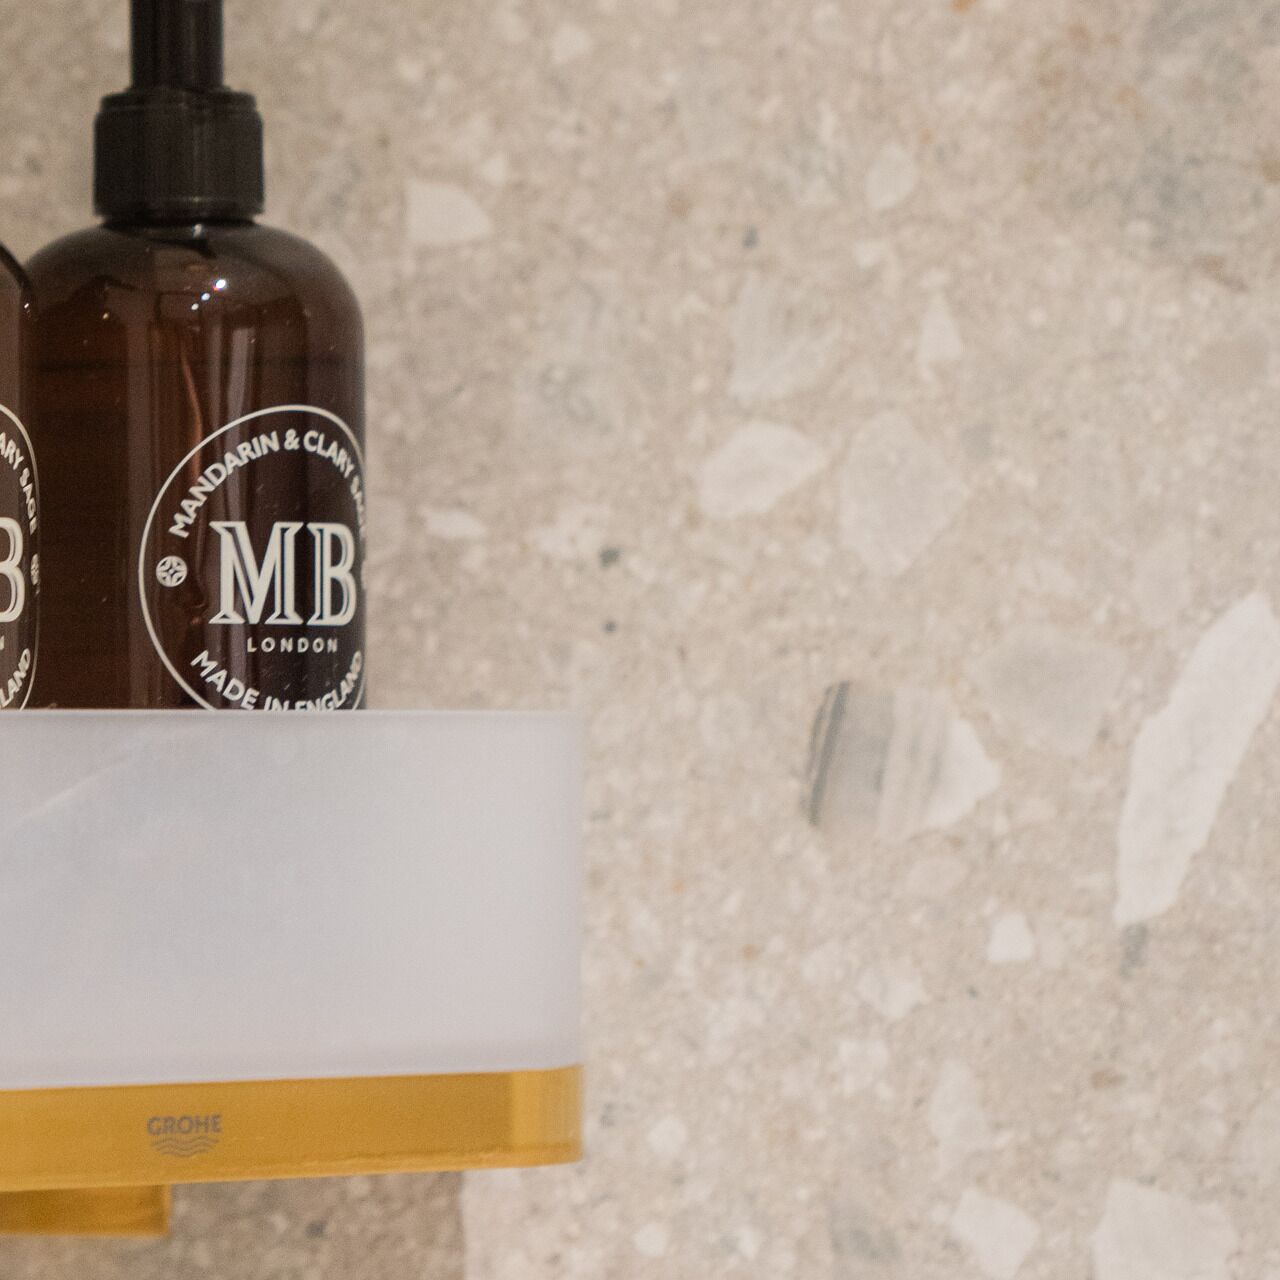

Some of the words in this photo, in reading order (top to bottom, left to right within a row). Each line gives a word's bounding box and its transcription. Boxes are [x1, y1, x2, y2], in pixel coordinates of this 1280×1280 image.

[168, 430, 280, 539] MANDARIN
[283, 428, 300, 451] &
[303, 430, 355, 479] CLARY
[208, 521, 358, 626] MB
[247, 637, 338, 654] LONDON
[190, 650, 260, 710] MADE
[146, 1114, 223, 1135] GROHE
